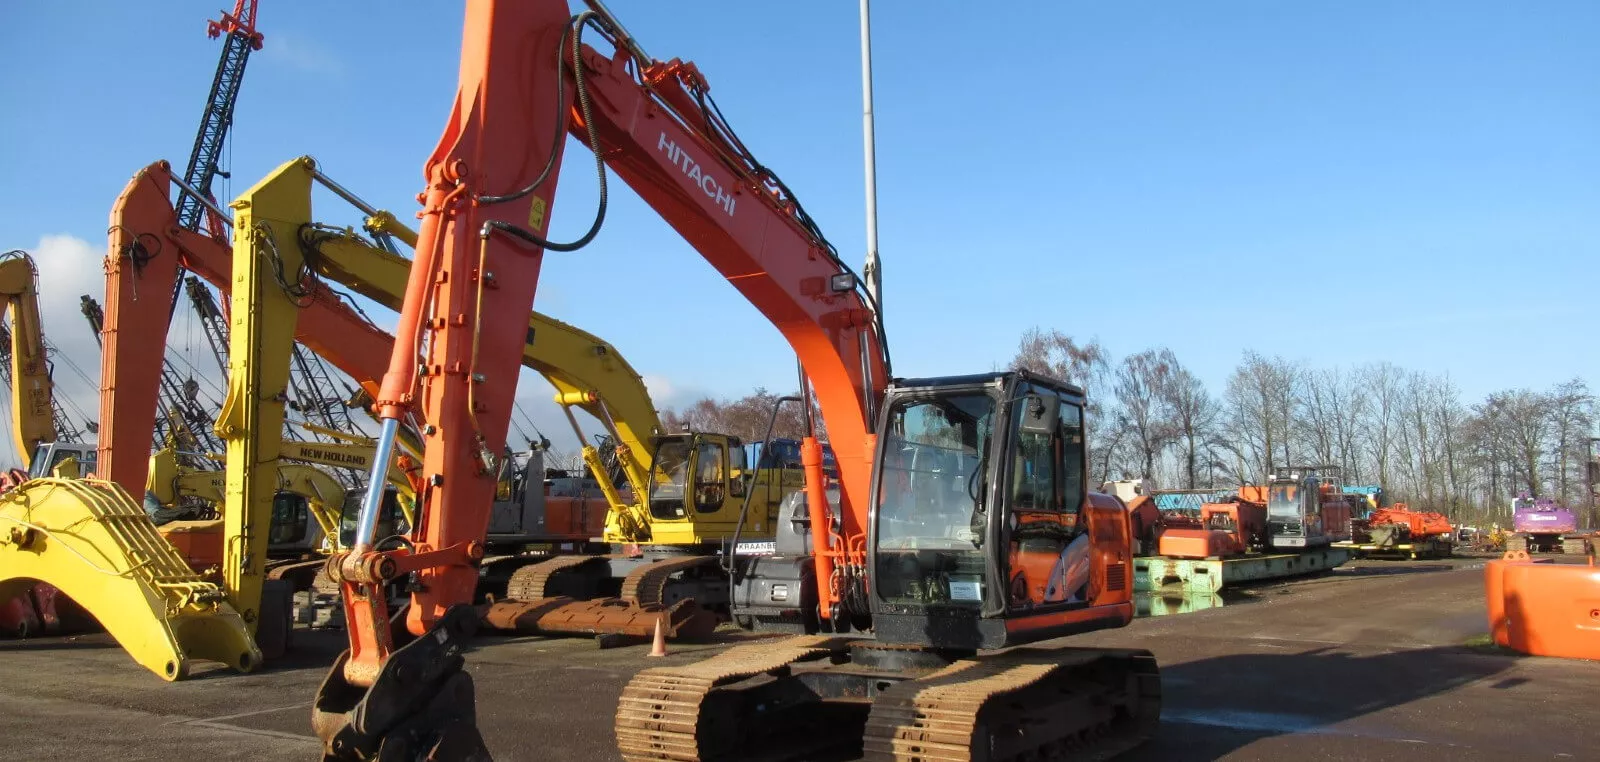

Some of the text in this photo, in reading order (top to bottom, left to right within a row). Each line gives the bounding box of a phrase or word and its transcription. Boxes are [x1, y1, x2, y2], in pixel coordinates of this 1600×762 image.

[656, 131, 736, 217] HITACHI
[300, 447, 366, 465] NEW HOLLAND
